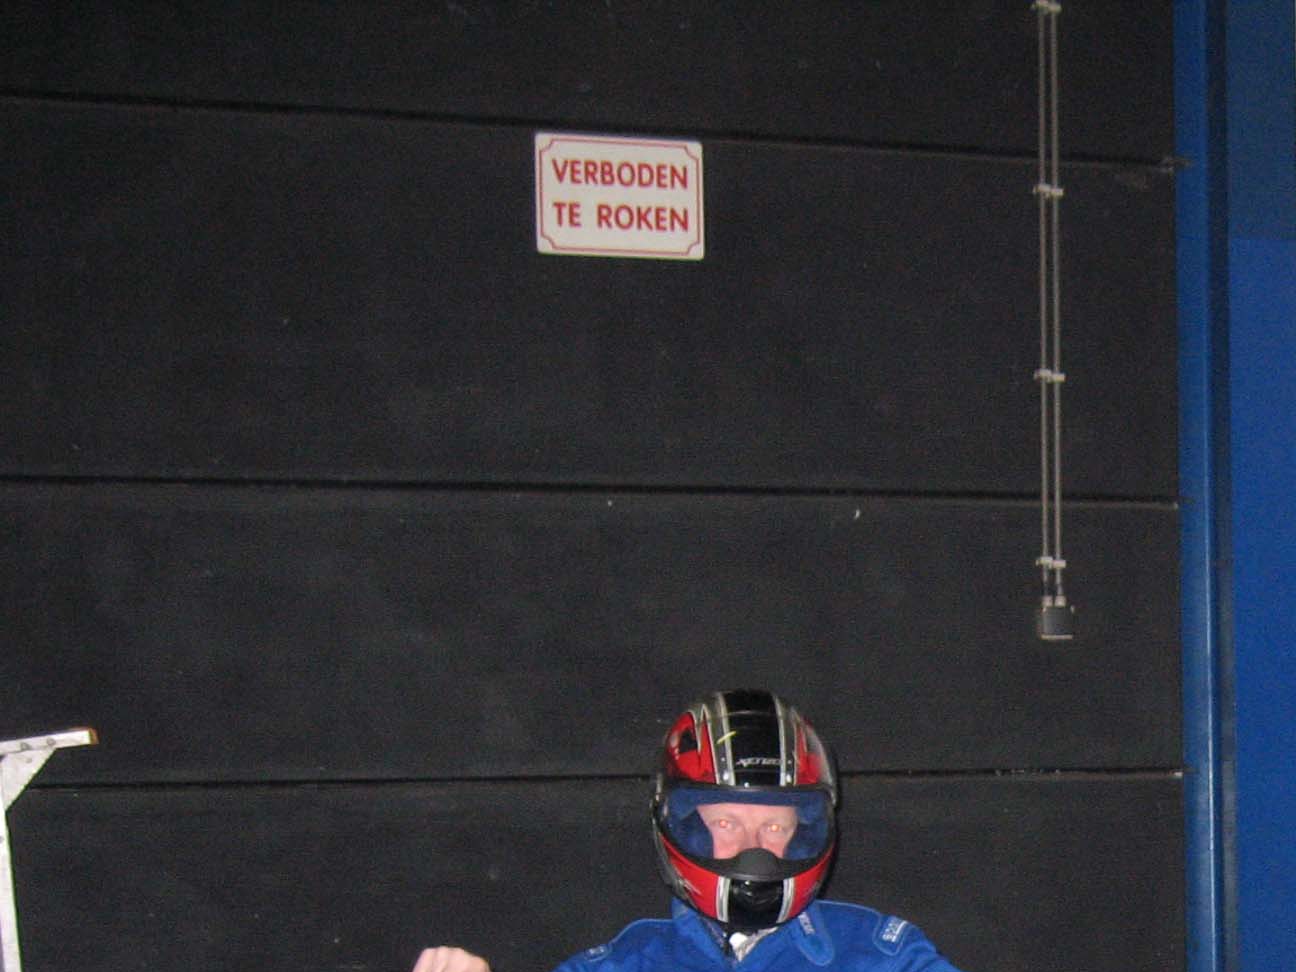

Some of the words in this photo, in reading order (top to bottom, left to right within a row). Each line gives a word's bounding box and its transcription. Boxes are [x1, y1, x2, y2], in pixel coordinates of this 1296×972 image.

[552, 158, 688, 189] VERBODEN
[553, 202, 582, 228] TE
[597, 203, 689, 232] ROKEN
